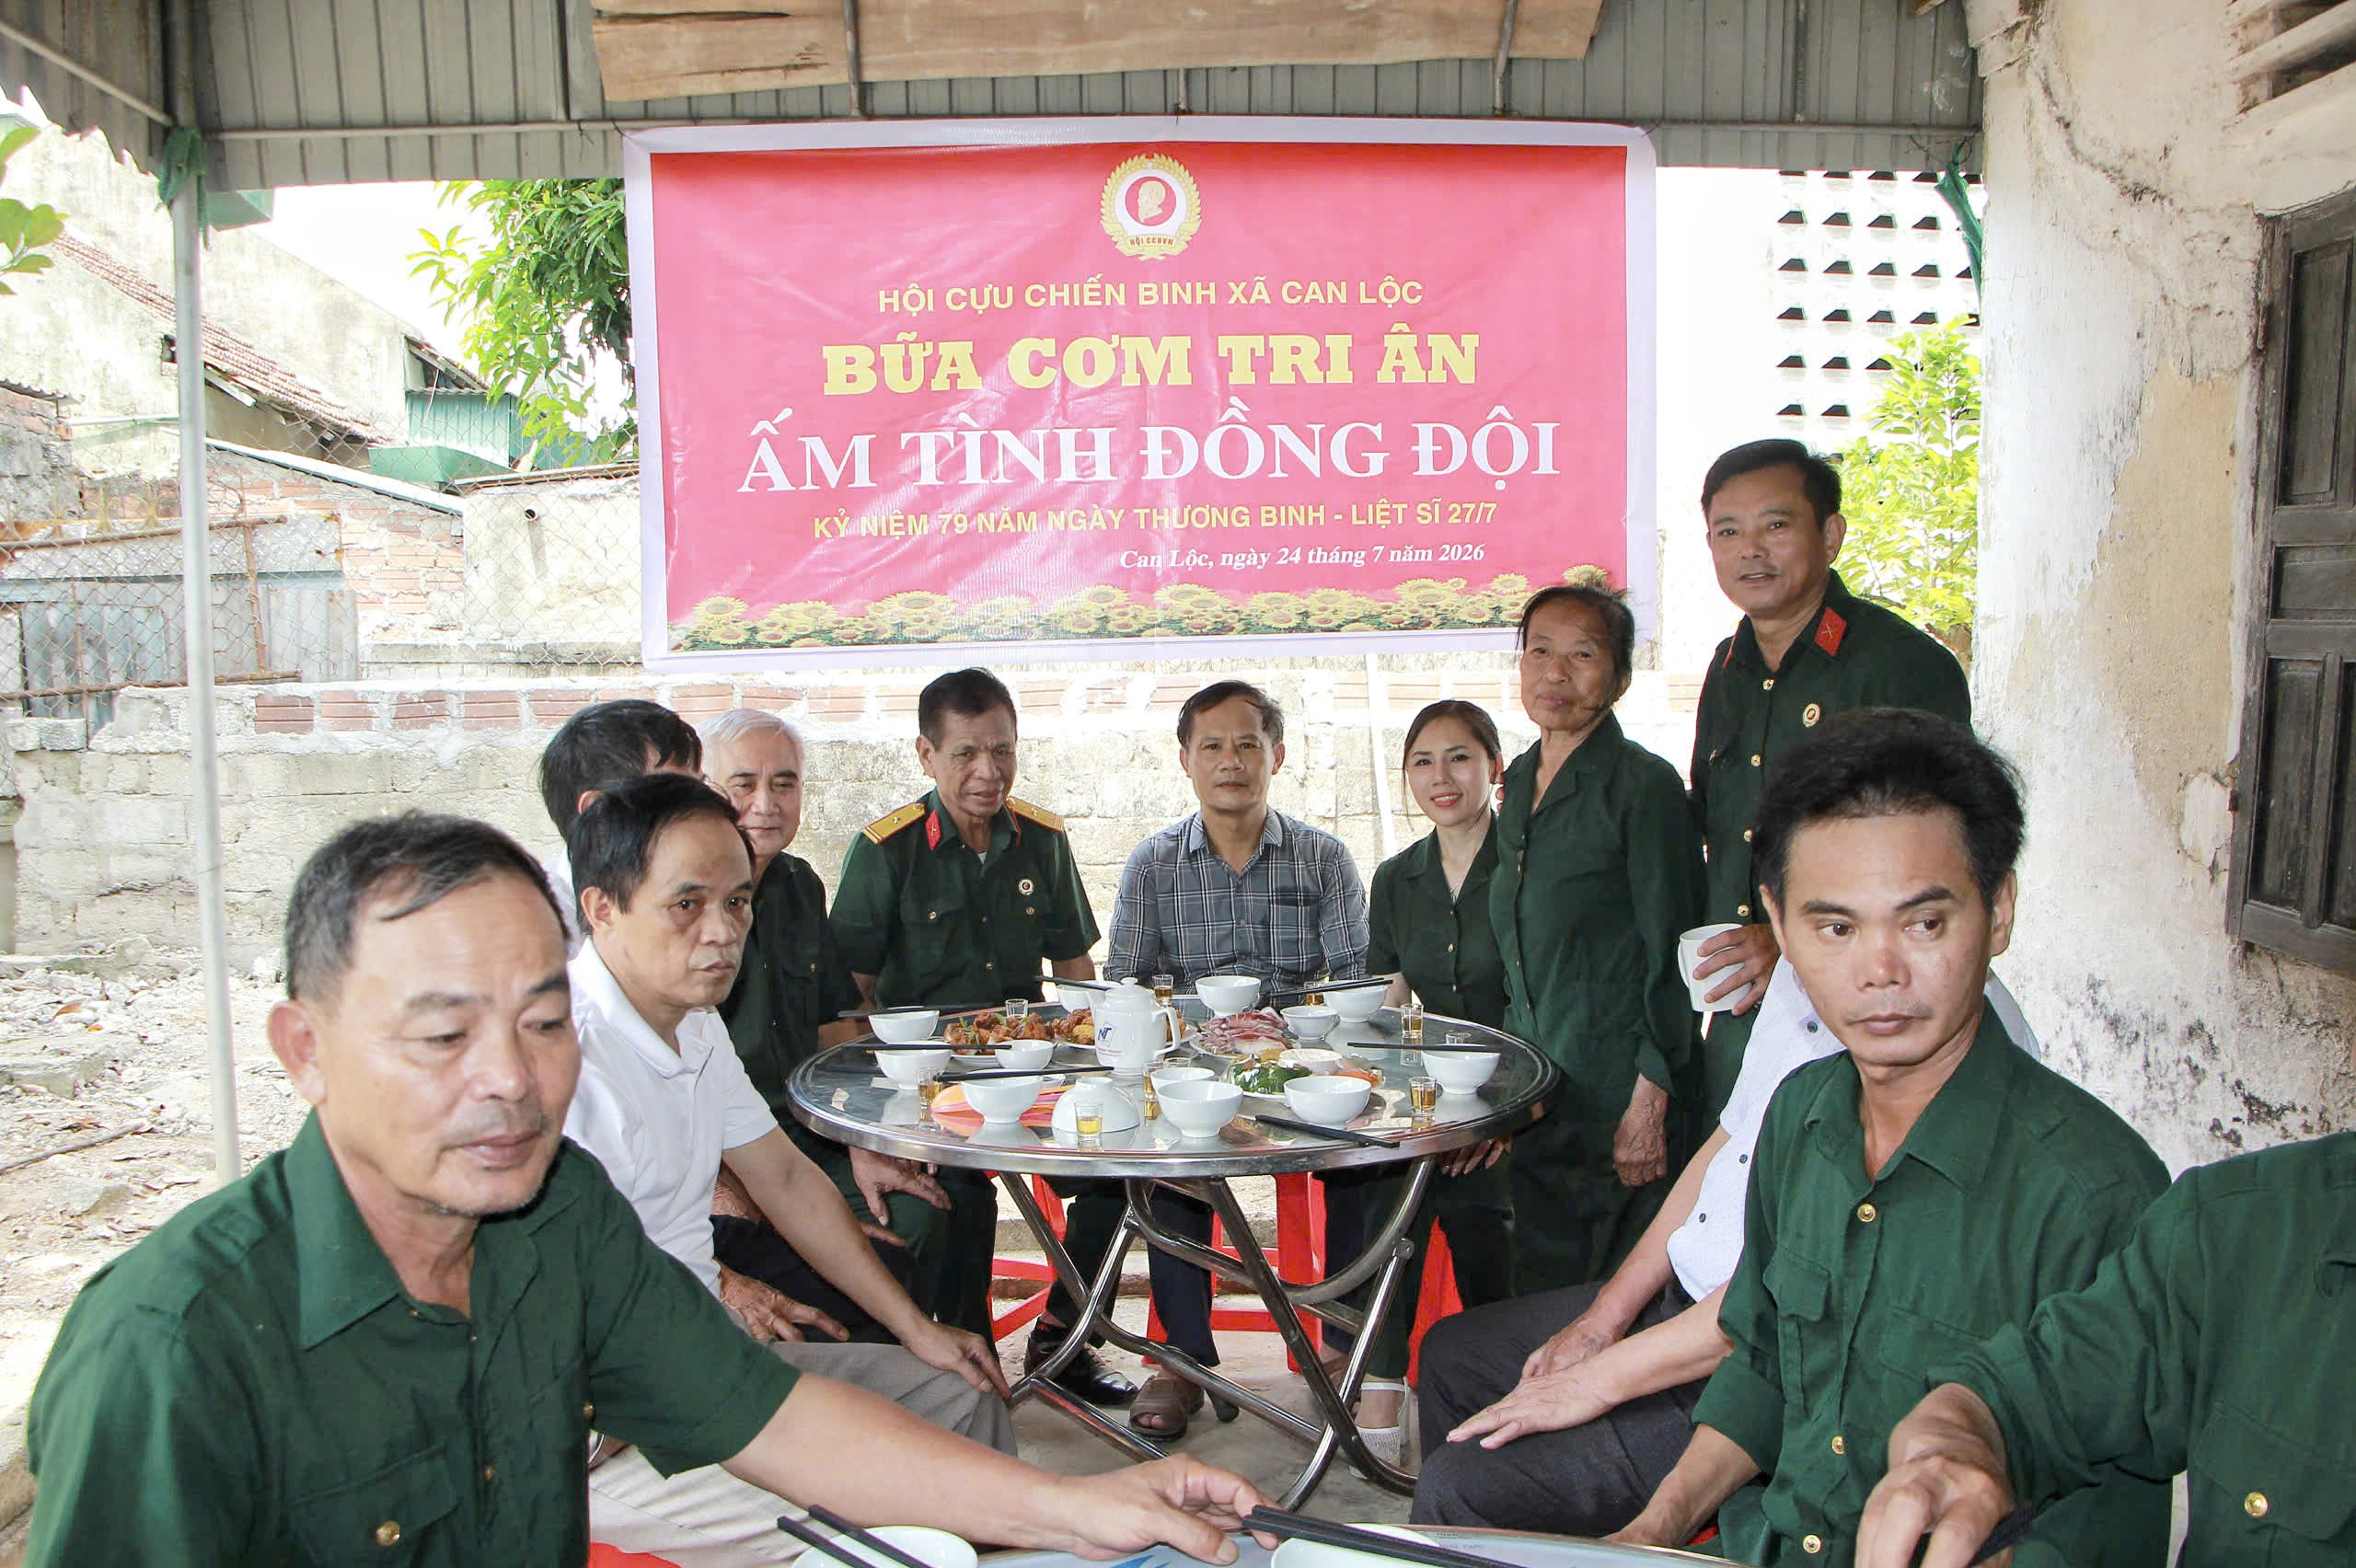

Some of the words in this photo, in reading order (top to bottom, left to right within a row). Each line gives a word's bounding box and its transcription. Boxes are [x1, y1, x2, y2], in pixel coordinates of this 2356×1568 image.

[879, 283, 934, 317] HỘI
[945, 283, 1013, 315] CỰU
[1024, 273, 1126, 306] CHIẾN
[1138, 282, 1216, 305] BINH
[1229, 275, 1272, 305] XÃ
[1281, 281, 1347, 305] CAN
[1359, 275, 1423, 308] LỘC
[822, 332, 982, 396] BỮA
[1008, 333, 1192, 389] CƠM
[1218, 333, 1354, 386] TRI
[1376, 323, 1479, 384] ÂN
[736, 407, 877, 492] ẤM
[900, 412, 1119, 488] TÌNH
[1139, 396, 1391, 481] ĐỒNG
[1412, 405, 1561, 491] ĐỘI
[814, 507, 851, 538] KỶ
[861, 510, 929, 541] NIỆM
[939, 511, 968, 535] 79
[977, 506, 1038, 534] NĂM
[1047, 504, 1124, 532] NGÀY
[1134, 503, 1251, 530] THƯƠNG
[1260, 503, 1326, 526] BINH
[1351, 498, 1410, 530] LIỆT
[1415, 497, 1441, 525] SĨ
[1448, 502, 1498, 525] 27/7
[1120, 548, 1162, 569] Can
[1169, 547, 1215, 571] Lộc,
[1219, 548, 1271, 571] ngày
[1276, 547, 1301, 565] 24
[1307, 545, 1365, 568] tháng
[1371, 546, 1384, 563] 7
[1389, 545, 1433, 563] năm
[1438, 543, 1485, 562] 2026
